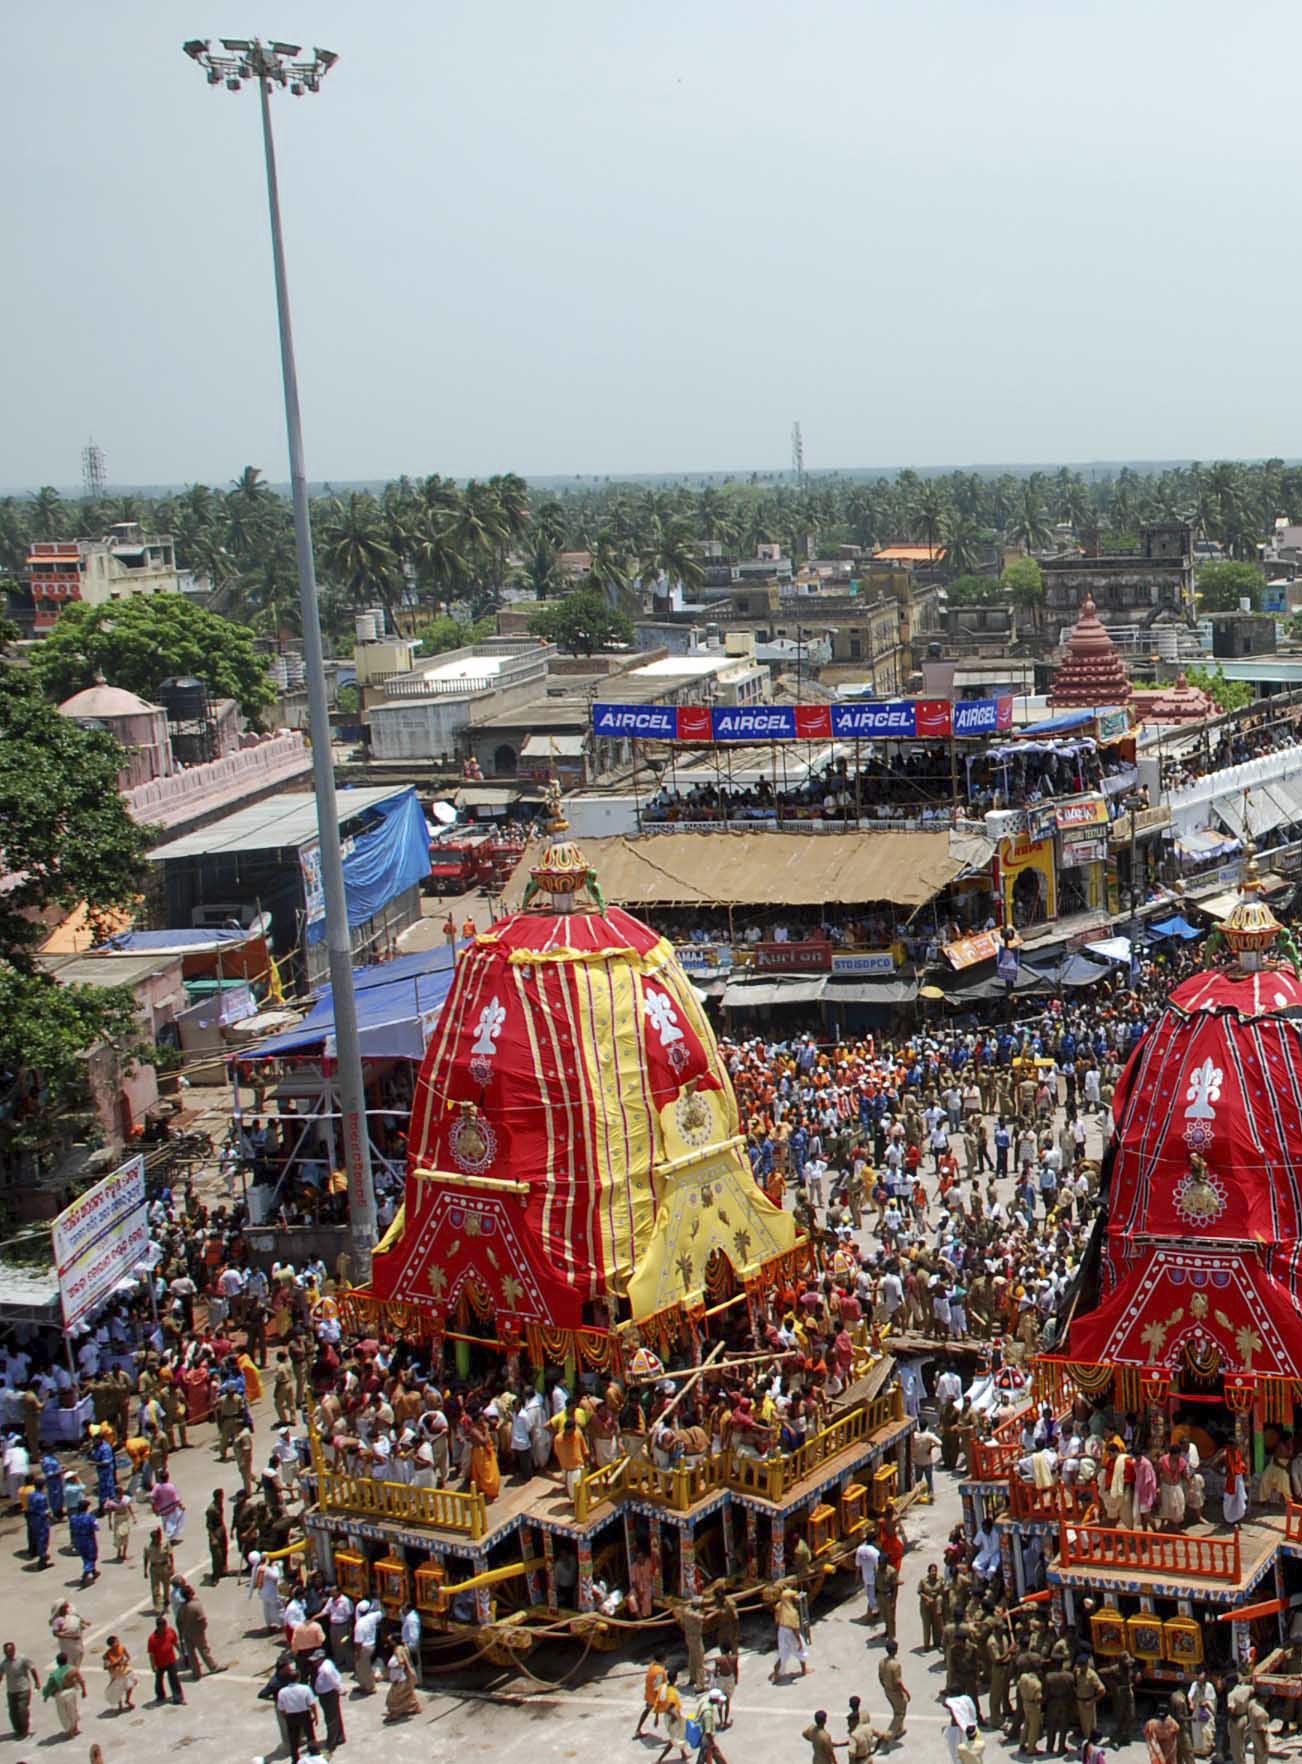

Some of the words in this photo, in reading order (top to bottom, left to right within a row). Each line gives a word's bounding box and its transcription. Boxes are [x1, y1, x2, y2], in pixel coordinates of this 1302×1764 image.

[600, 713, 672, 729] AIRCEL
[718, 715, 791, 731] AIRCEL
[838, 712, 910, 728] AIRCEL
[957, 706, 995, 728] AIRCEL
